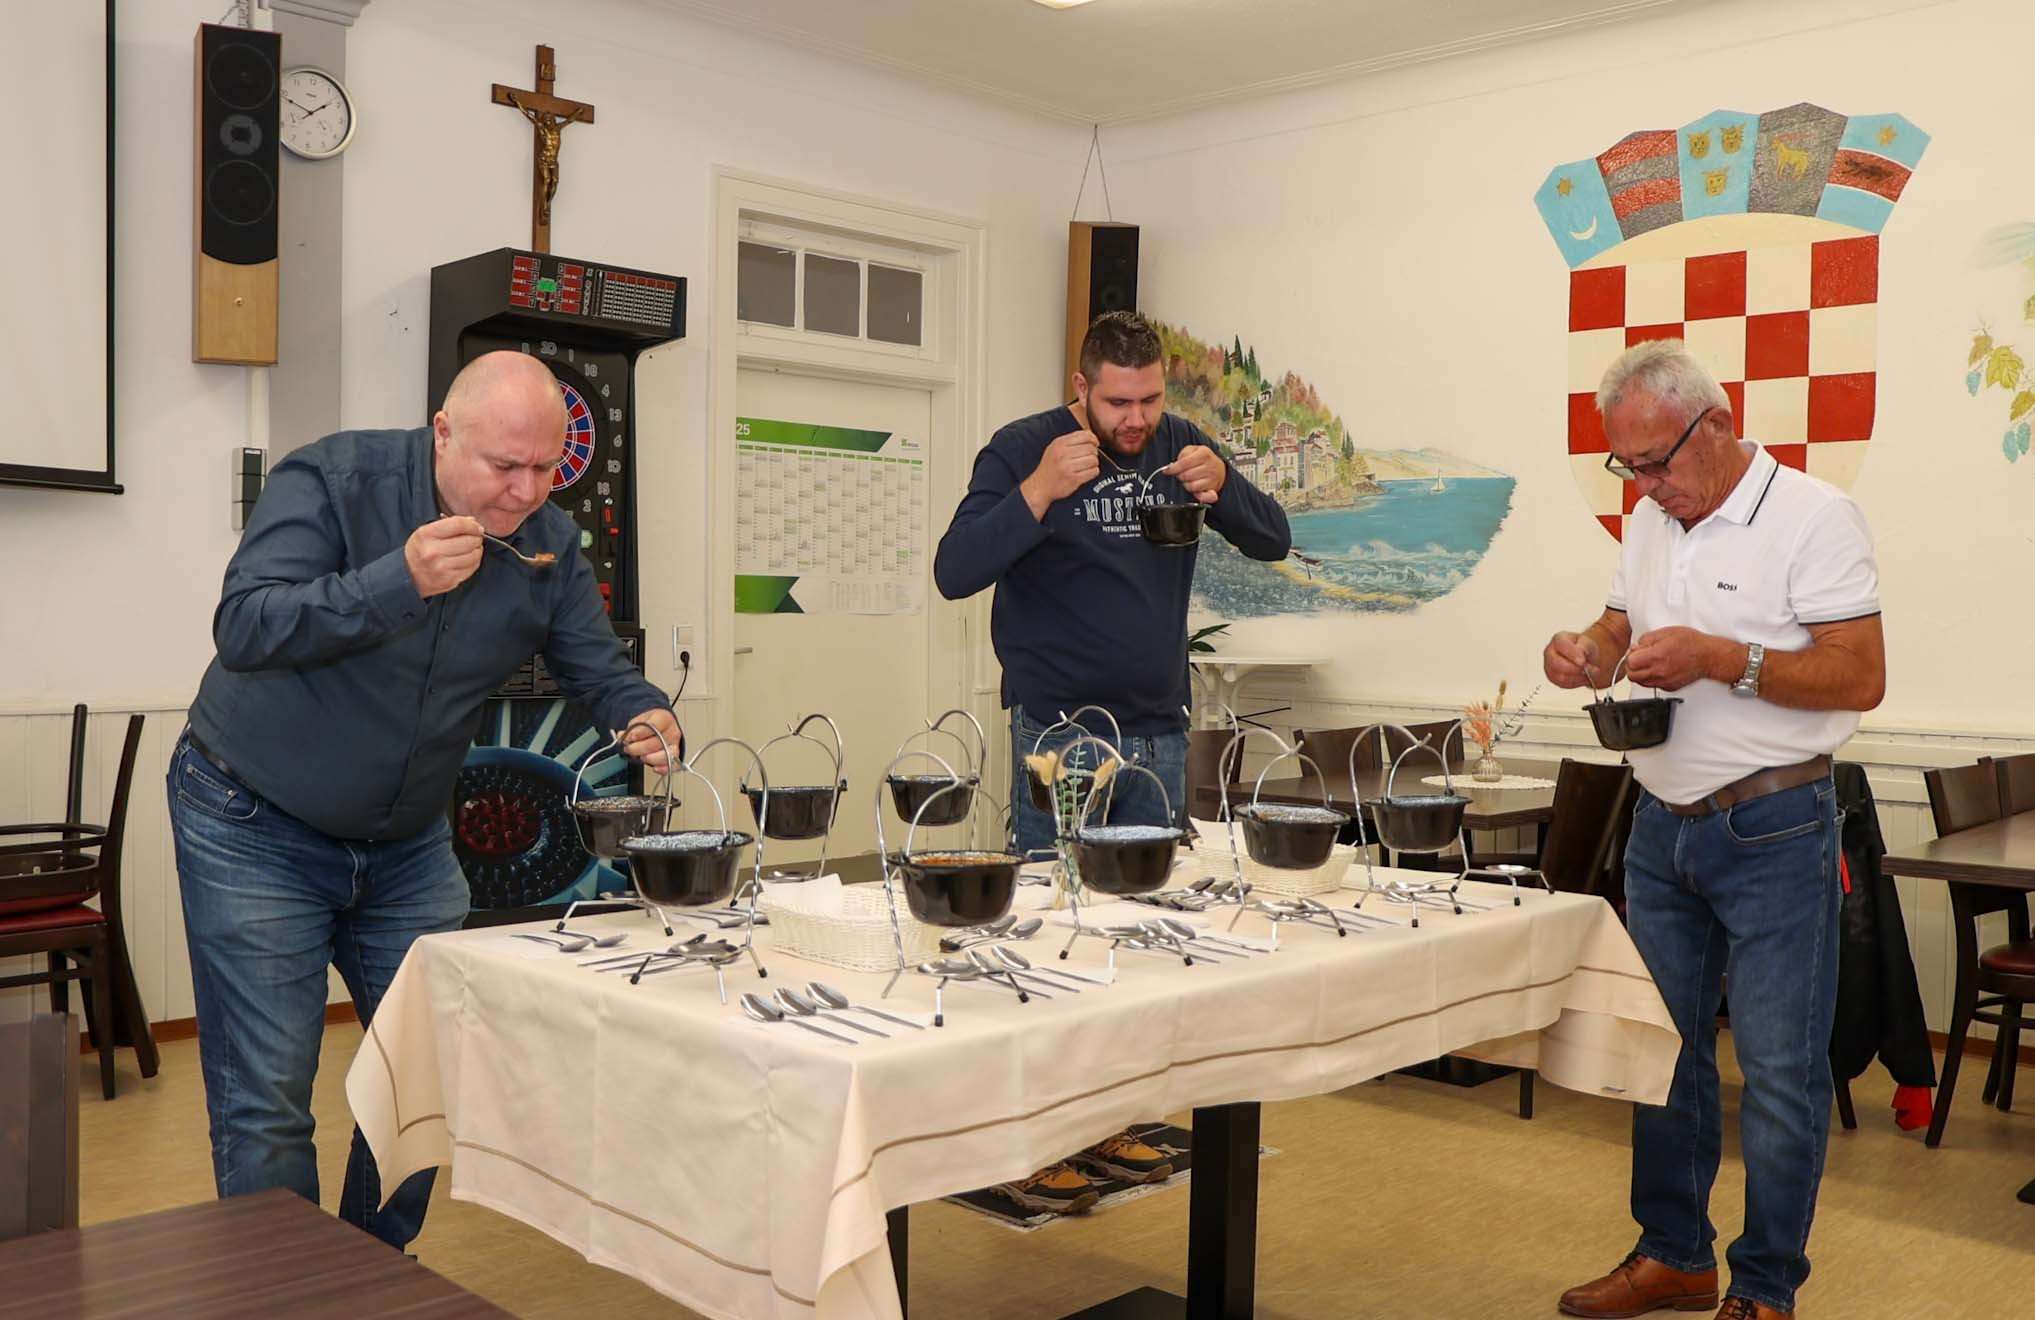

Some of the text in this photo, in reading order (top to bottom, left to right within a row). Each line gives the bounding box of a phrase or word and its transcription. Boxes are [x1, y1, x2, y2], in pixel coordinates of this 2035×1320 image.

[541, 340, 557, 355] 20
[568, 348, 575, 362] 1
[601, 383, 610, 398] 4
[609, 408, 622, 422] 13
[736, 423, 750, 436] 25
[613, 434, 622, 448] 6
[607, 459, 621, 474] 10
[582, 499, 592, 513] 2
[1083, 493, 1166, 522] MUST
